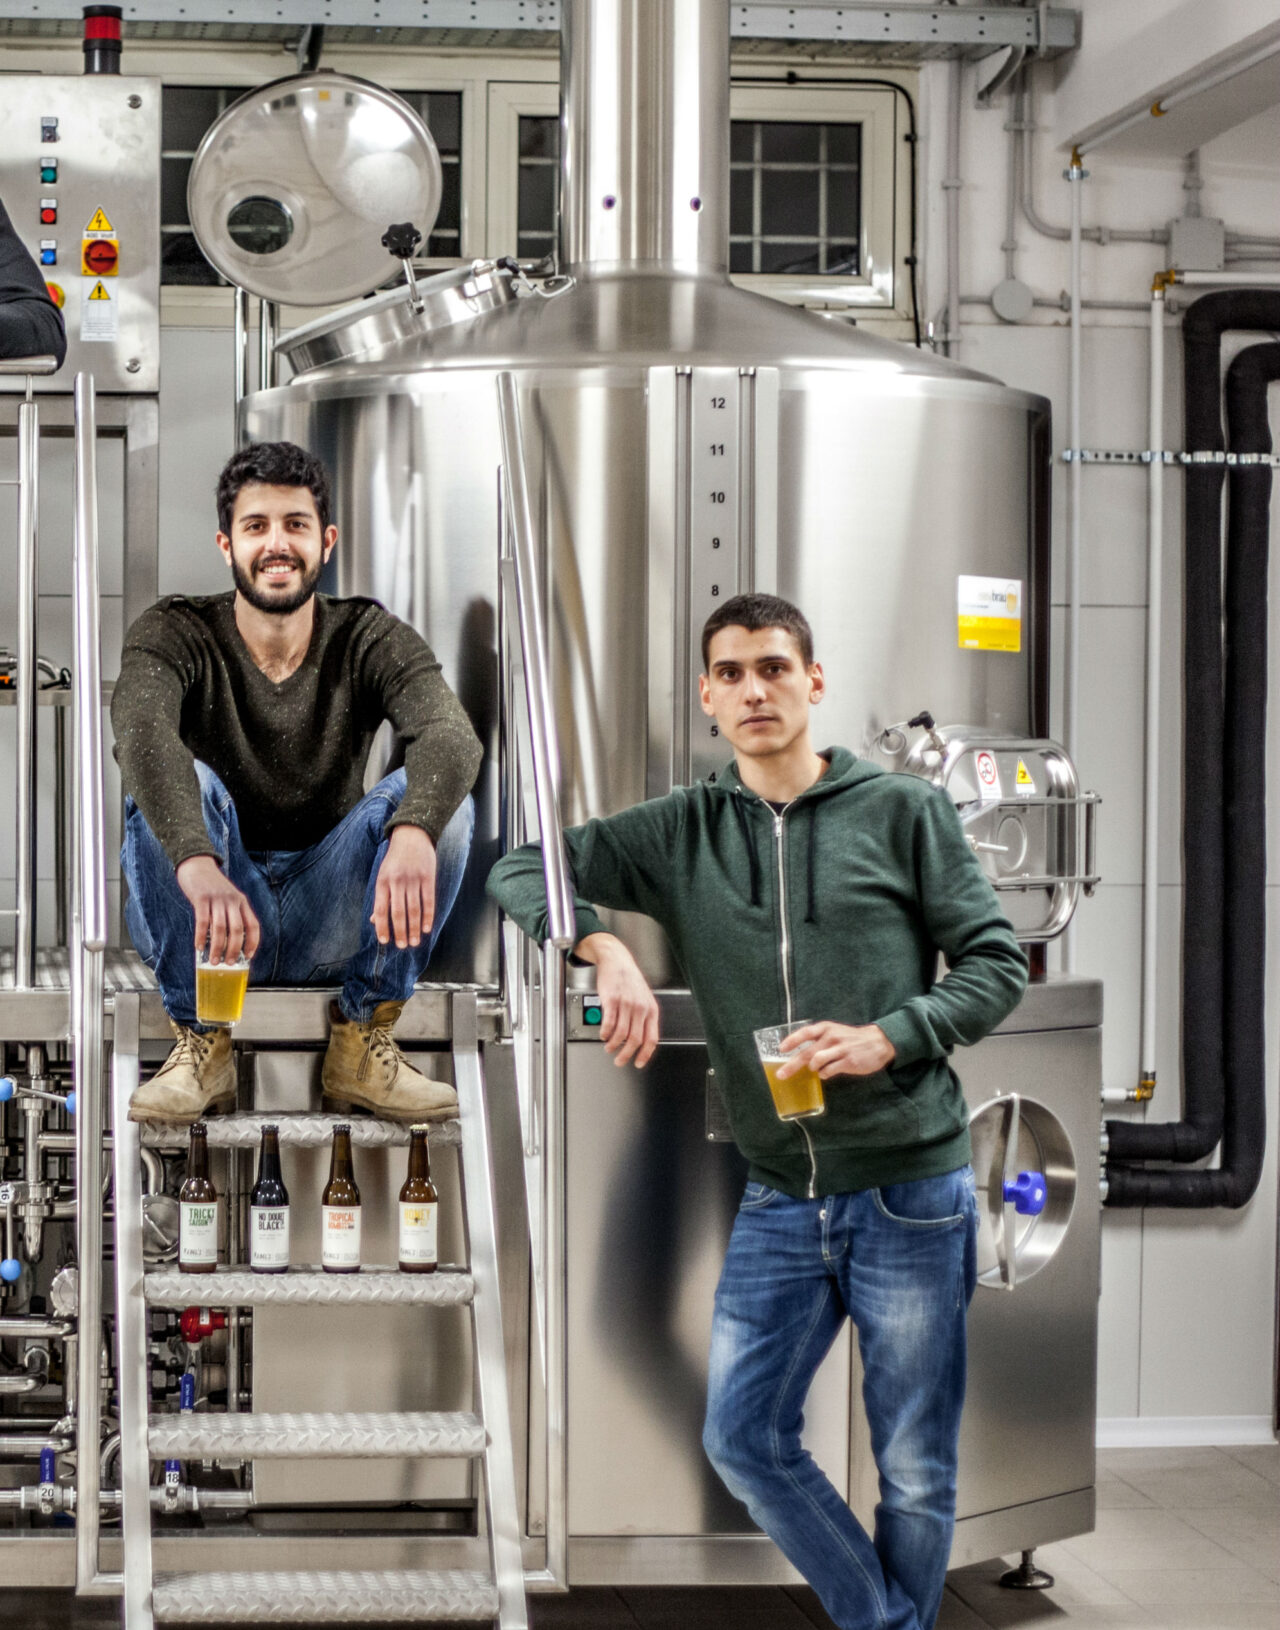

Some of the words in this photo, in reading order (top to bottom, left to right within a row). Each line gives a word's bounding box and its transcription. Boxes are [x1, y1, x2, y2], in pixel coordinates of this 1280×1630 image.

[710, 397, 726, 409] 12
[710, 444, 725, 456] 11
[710, 492, 725, 504] 10
[712, 537, 720, 549] 9
[711, 585, 719, 597] 8
[711, 725, 719, 737] 5
[708, 771, 717, 783] 4
[1, 1189, 10, 1200] 16
[258, 1220, 280, 1231] BLACK
[167, 1472, 179, 1483] 18
[41, 1487, 54, 1498] 20
